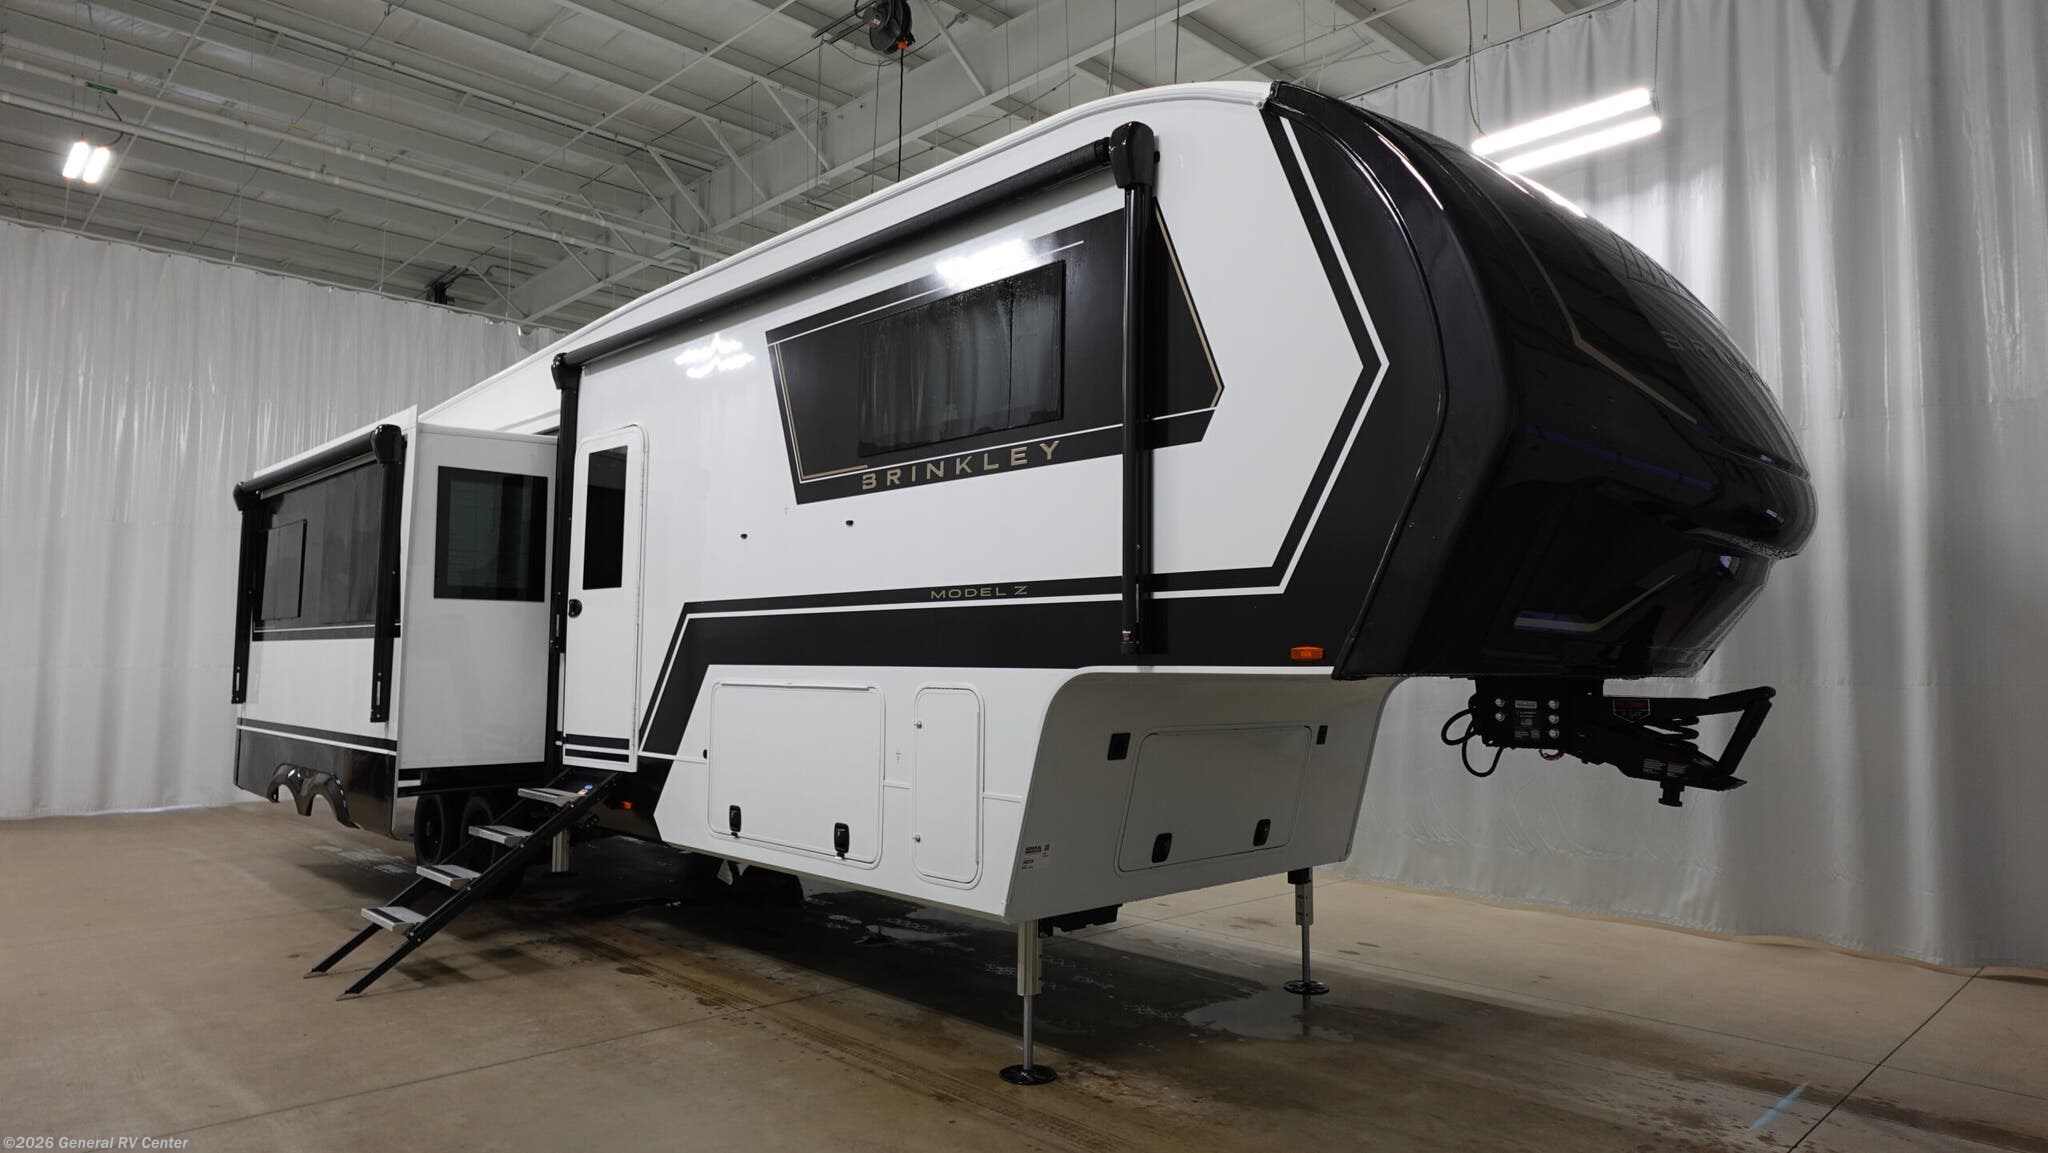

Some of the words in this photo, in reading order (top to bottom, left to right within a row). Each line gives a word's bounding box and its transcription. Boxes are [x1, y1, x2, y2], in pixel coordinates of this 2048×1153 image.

[862, 440, 1060, 490] BRINKLEY
[931, 587, 1007, 600] MODEL
[1014, 585, 1028, 596] Z
